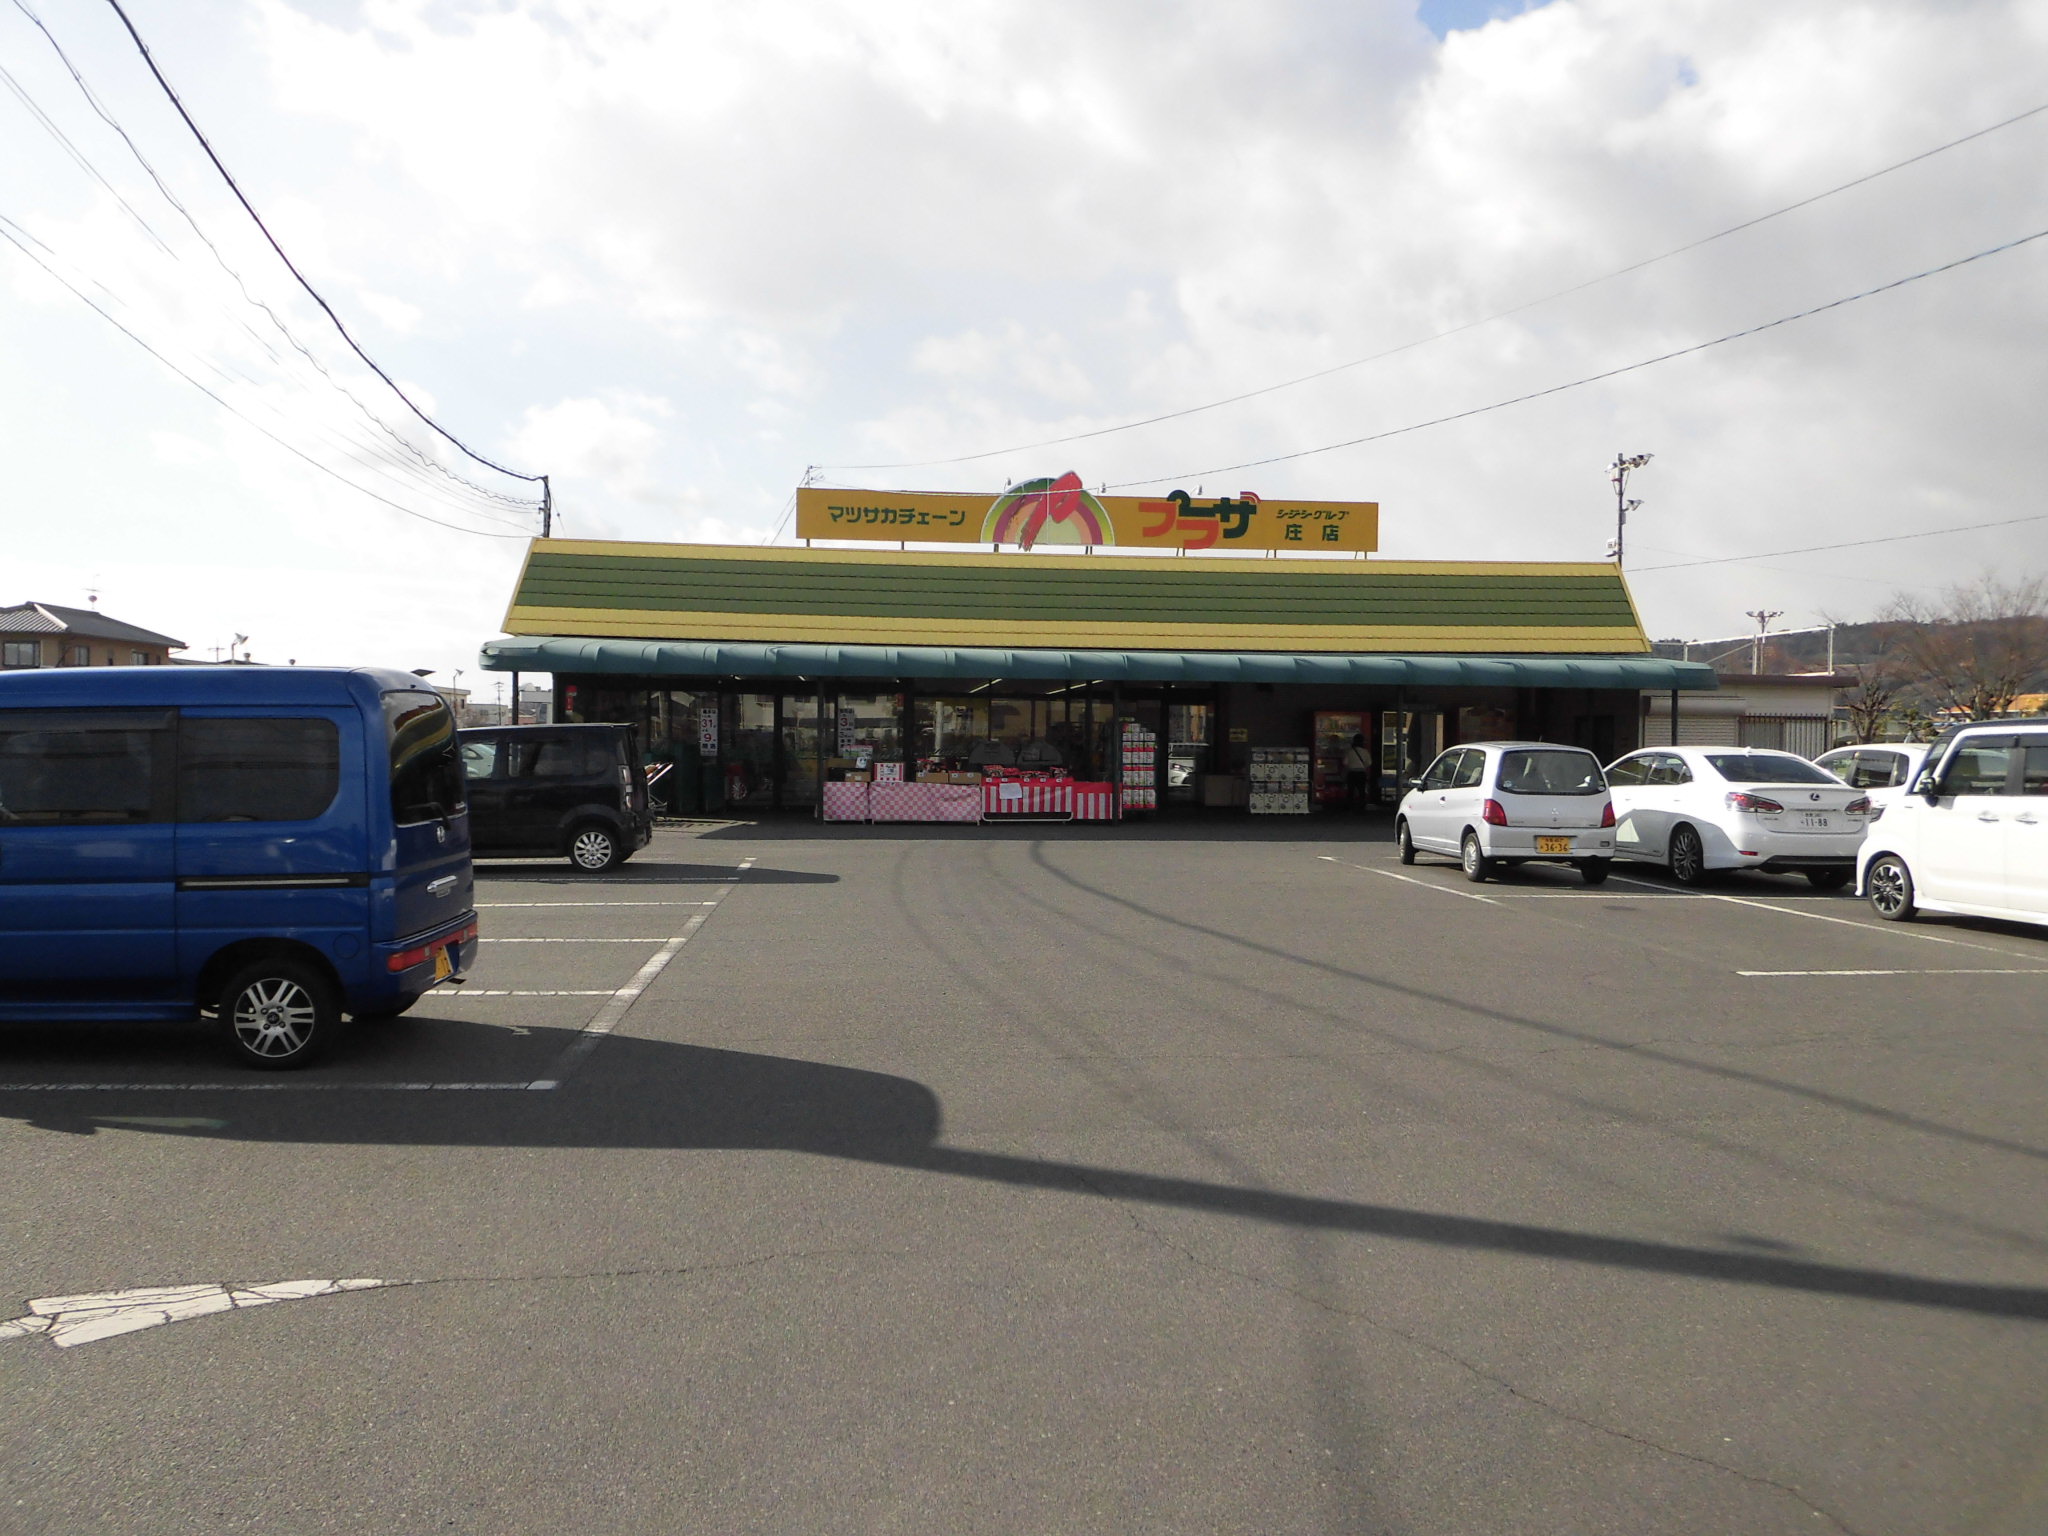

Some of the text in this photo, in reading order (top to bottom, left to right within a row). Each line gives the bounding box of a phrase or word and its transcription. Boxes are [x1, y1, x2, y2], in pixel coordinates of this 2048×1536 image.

[827, 505, 966, 527] マツサカチェーン
